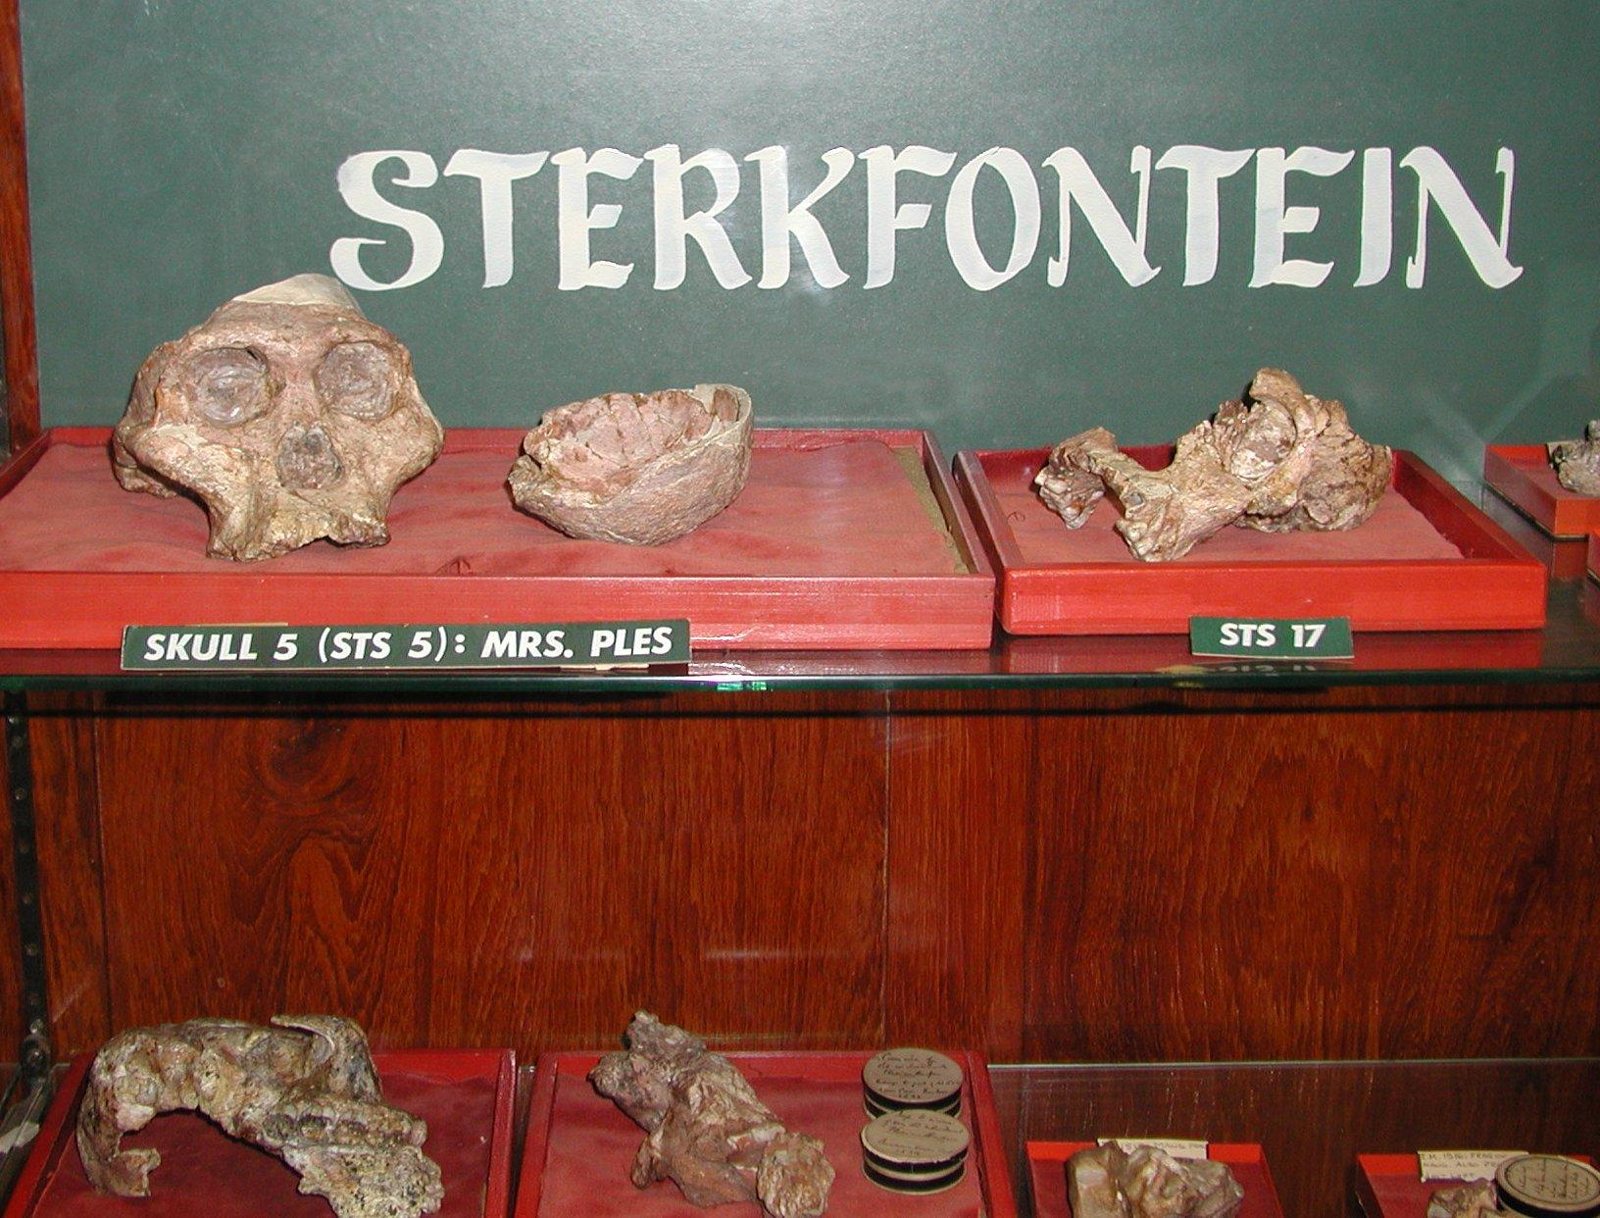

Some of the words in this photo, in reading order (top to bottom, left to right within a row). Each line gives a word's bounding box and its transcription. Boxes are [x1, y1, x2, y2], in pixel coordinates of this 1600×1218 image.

[330, 144, 1524, 292] STERKFONTEIN
[144, 633, 257, 661] SKULL
[273, 633, 298, 661] 5
[318, 627, 392, 663] (STS
[407, 626, 466, 662] 5):
[481, 630, 574, 659] MRS.
[590, 626, 673, 657] PLES
[1219, 622, 1276, 647] STS
[1291, 623, 1326, 648] 17
